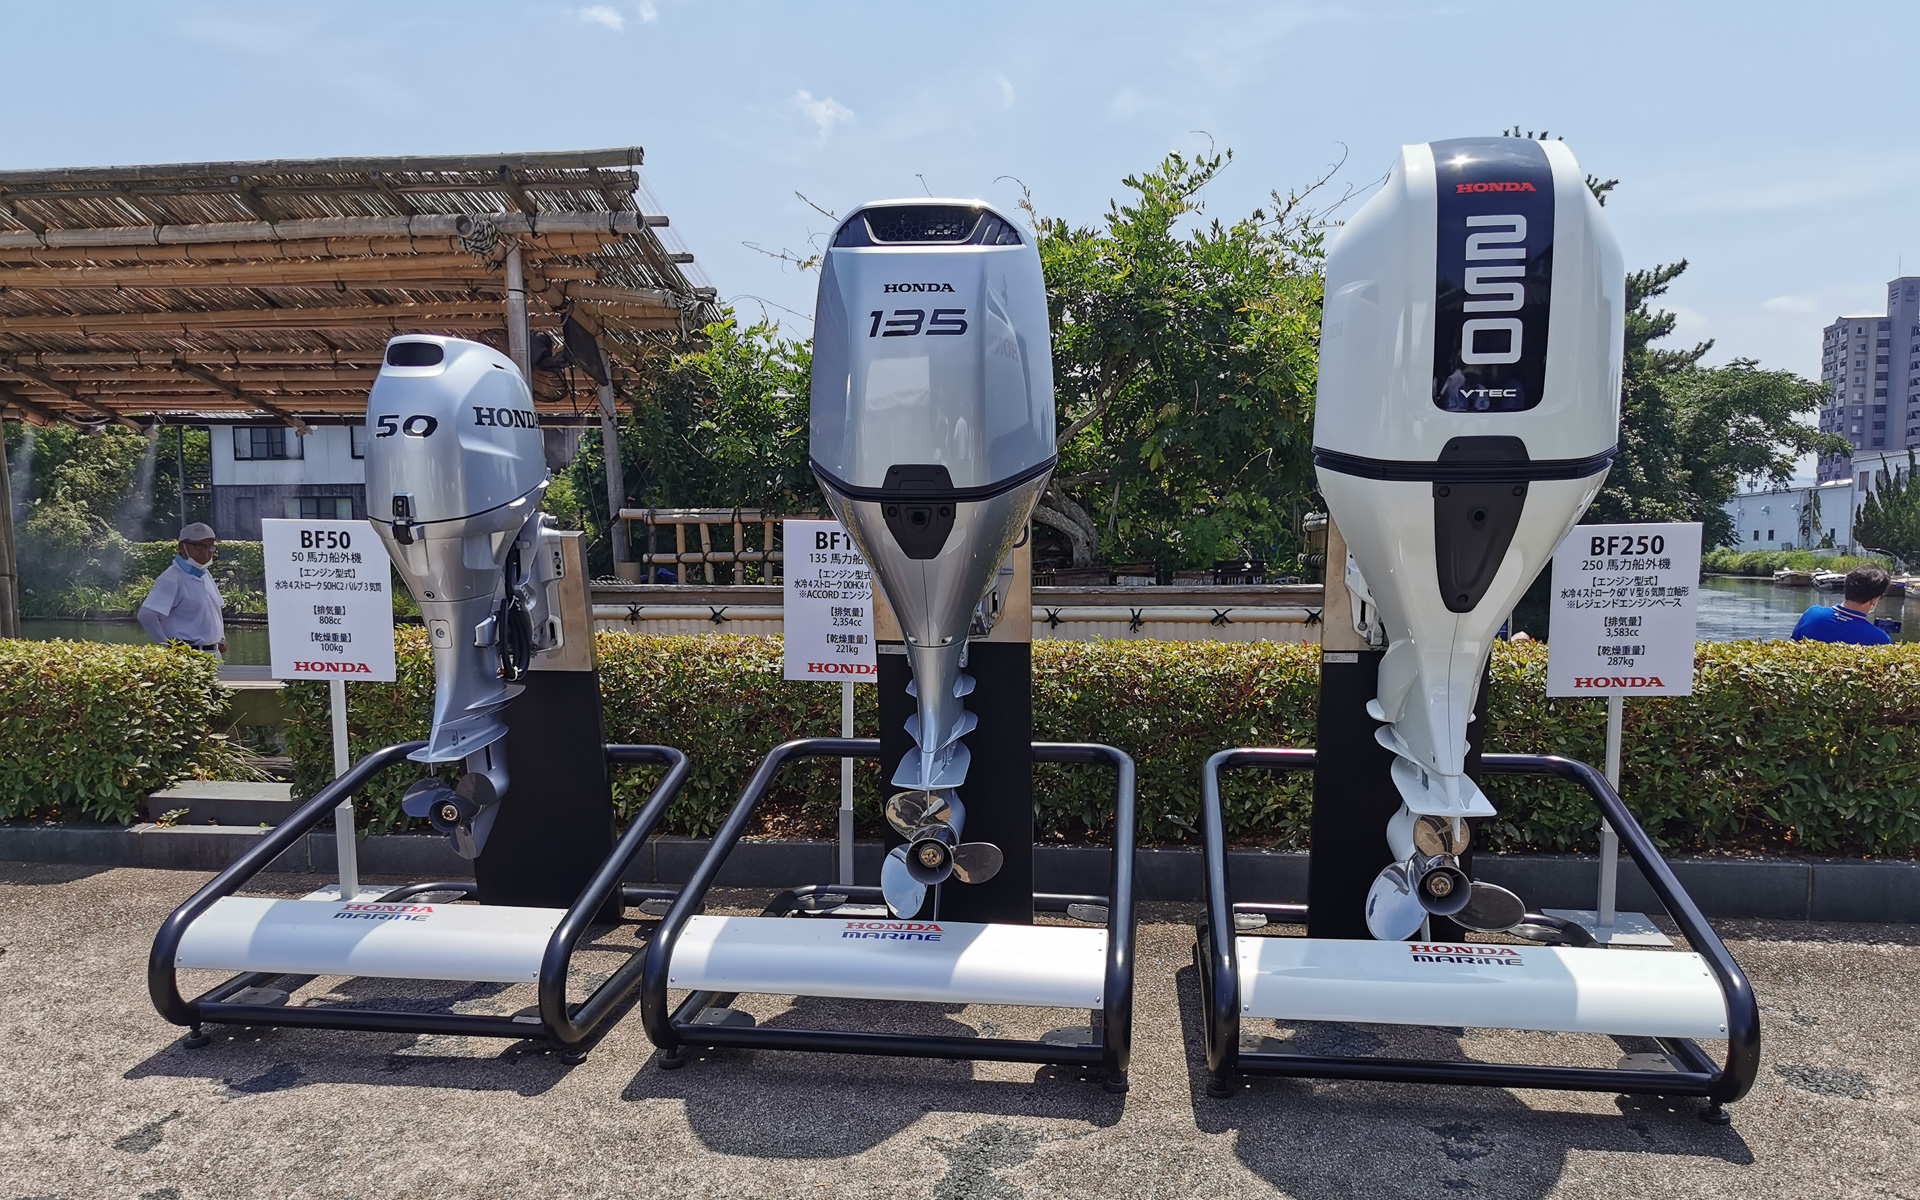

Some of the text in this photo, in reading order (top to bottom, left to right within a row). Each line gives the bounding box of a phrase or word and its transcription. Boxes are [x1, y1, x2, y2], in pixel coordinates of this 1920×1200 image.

[1456, 182, 1536, 193] HONDA
[884, 283, 955, 293] HONDA
[1461, 214, 1527, 365] 250
[869, 308, 968, 338] 135
[1460, 389, 1517, 398] VTEC
[375, 414, 438, 438] 50
[300, 530, 351, 549] BF50
[815, 531, 856, 550] BF1
[1590, 535, 1665, 556] BF250
[291, 552, 362, 564] 50 馬力船外機
[809, 553, 864, 565] 135 馬力船
[1582, 558, 1671, 571] 250 馬力船外機
[313, 605, 346, 616] 【排気量】
[829, 607, 864, 618] 【排気量】
[319, 616, 342, 625] 808cc
[832, 617, 862, 627] 2,354cc
[1603, 616, 1642, 627] 【排気量】
[1605, 627, 1639, 637] 3,583cc
[320, 643, 344, 654] 100kg
[836, 645, 859, 656] 221kg
[294, 661, 372, 673] HONDA
[1607, 657, 1634, 667] 287kg
[1573, 677, 1665, 688] HONDA
[342, 904, 435, 913] HONDA
[844, 922, 944, 932] HONDA
[1408, 944, 1521, 956] HONDA
